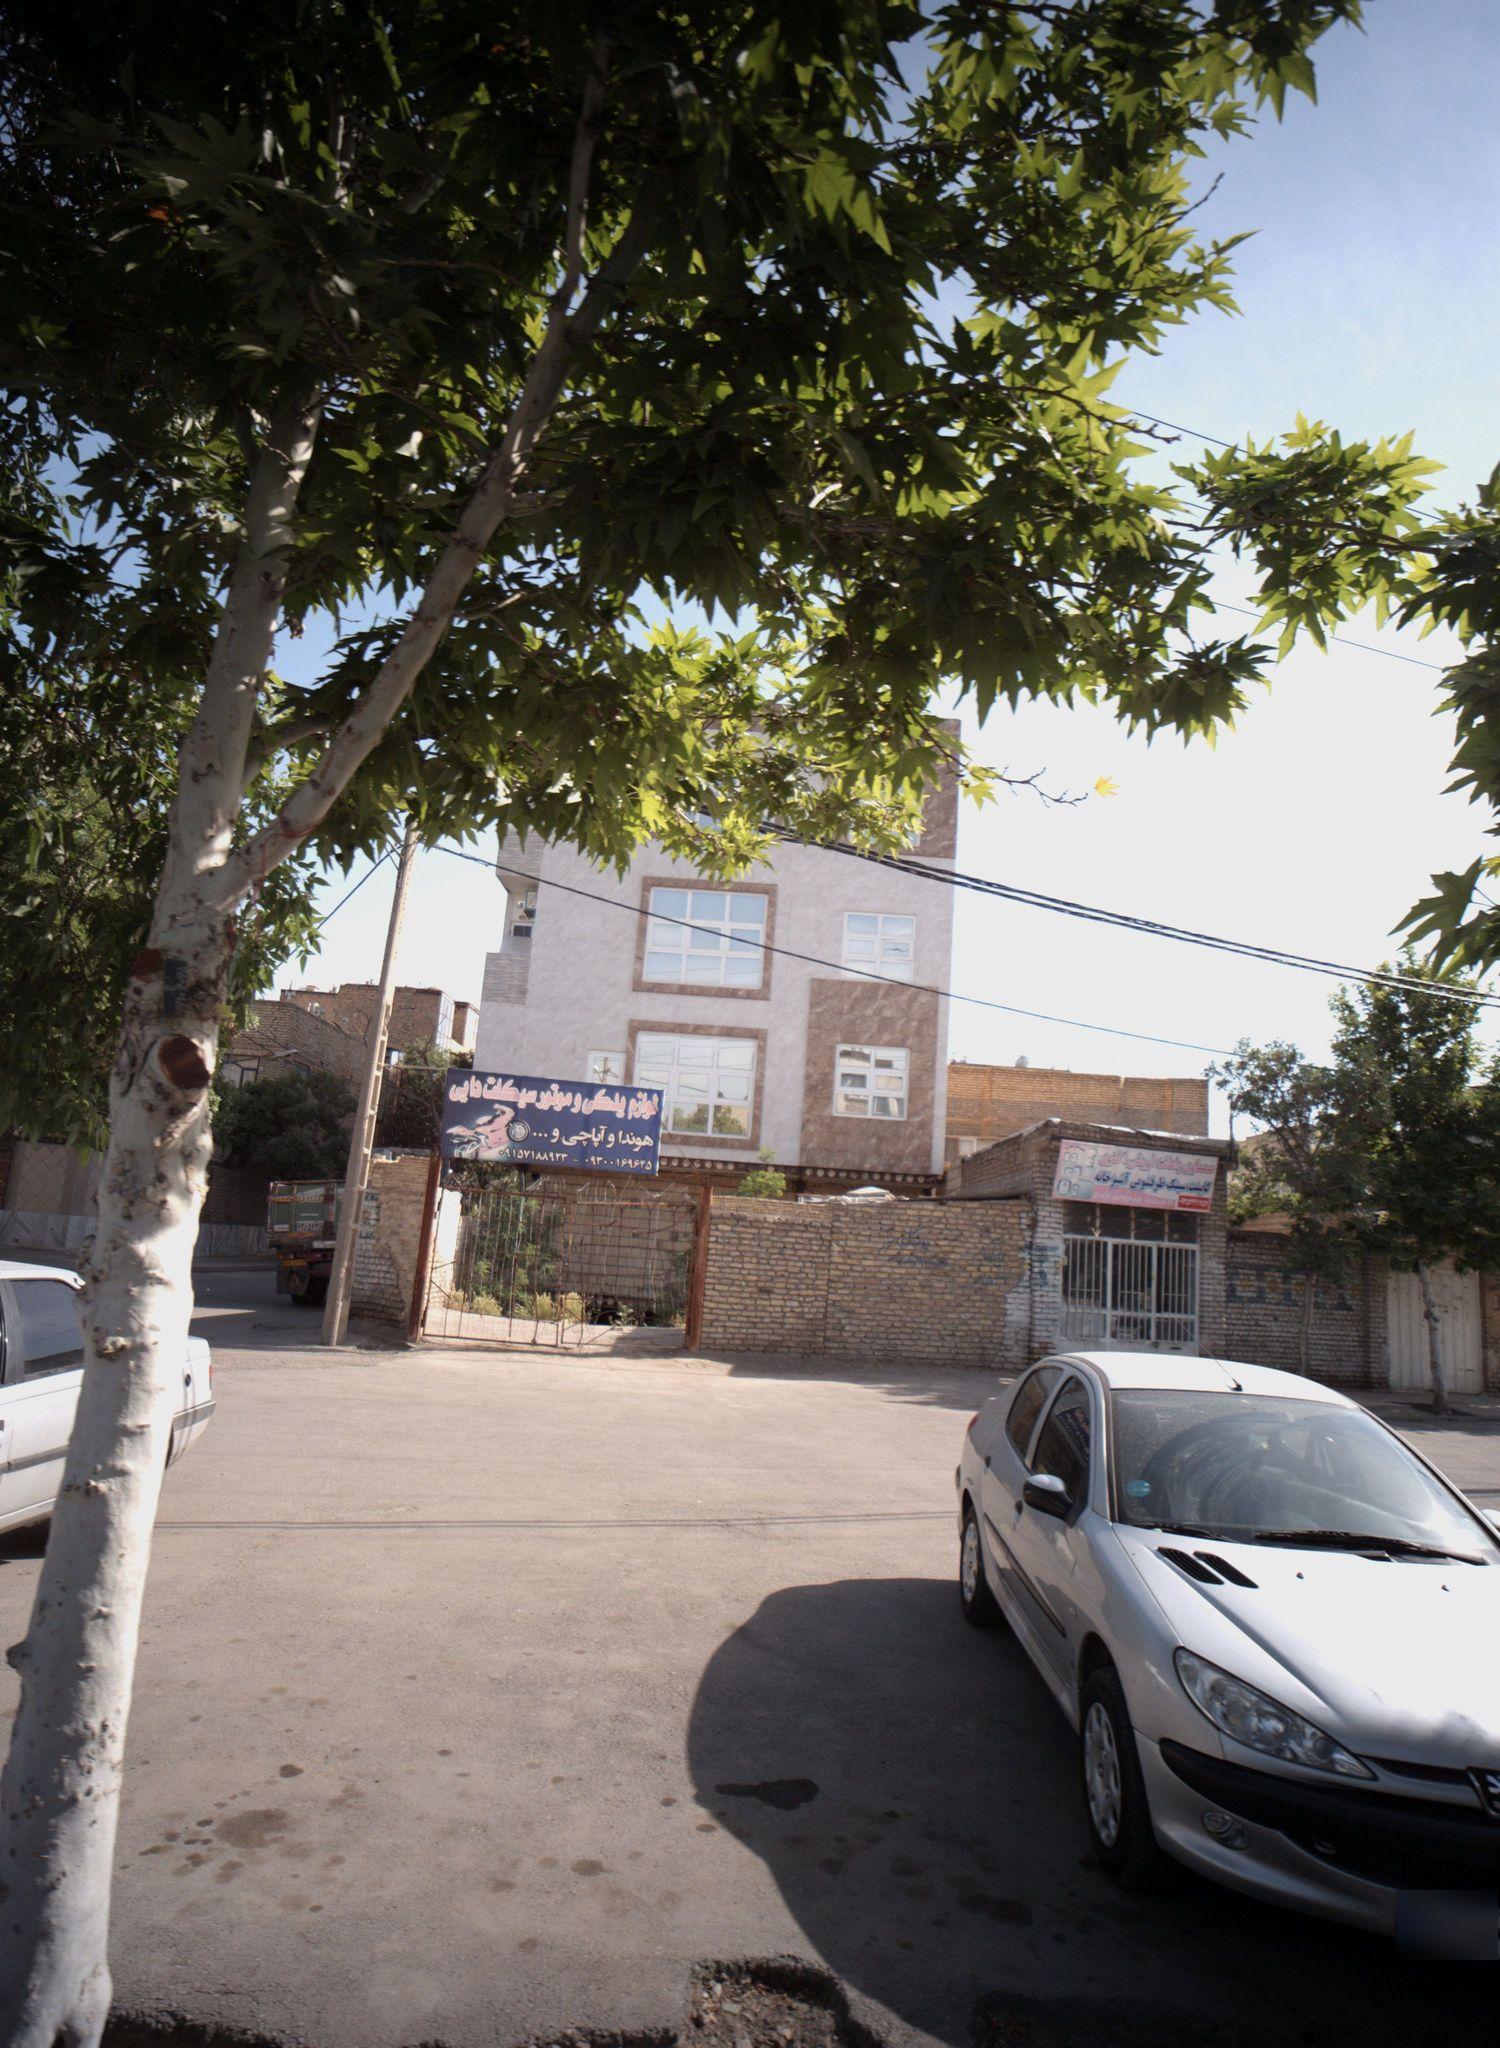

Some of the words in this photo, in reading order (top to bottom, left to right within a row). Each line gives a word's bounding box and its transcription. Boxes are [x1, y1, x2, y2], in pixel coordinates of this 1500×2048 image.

[570, 1093, 582, 1113] و
[582, 1088, 626, 1118] یدکی
[628, 1091, 659, 1120] لوازم
[550, 1127, 560, 1143] و
[562, 1126, 607, 1148] آپاچی
[606, 1132, 615, 1148] و
[618, 1130, 654, 1152] هوندا
